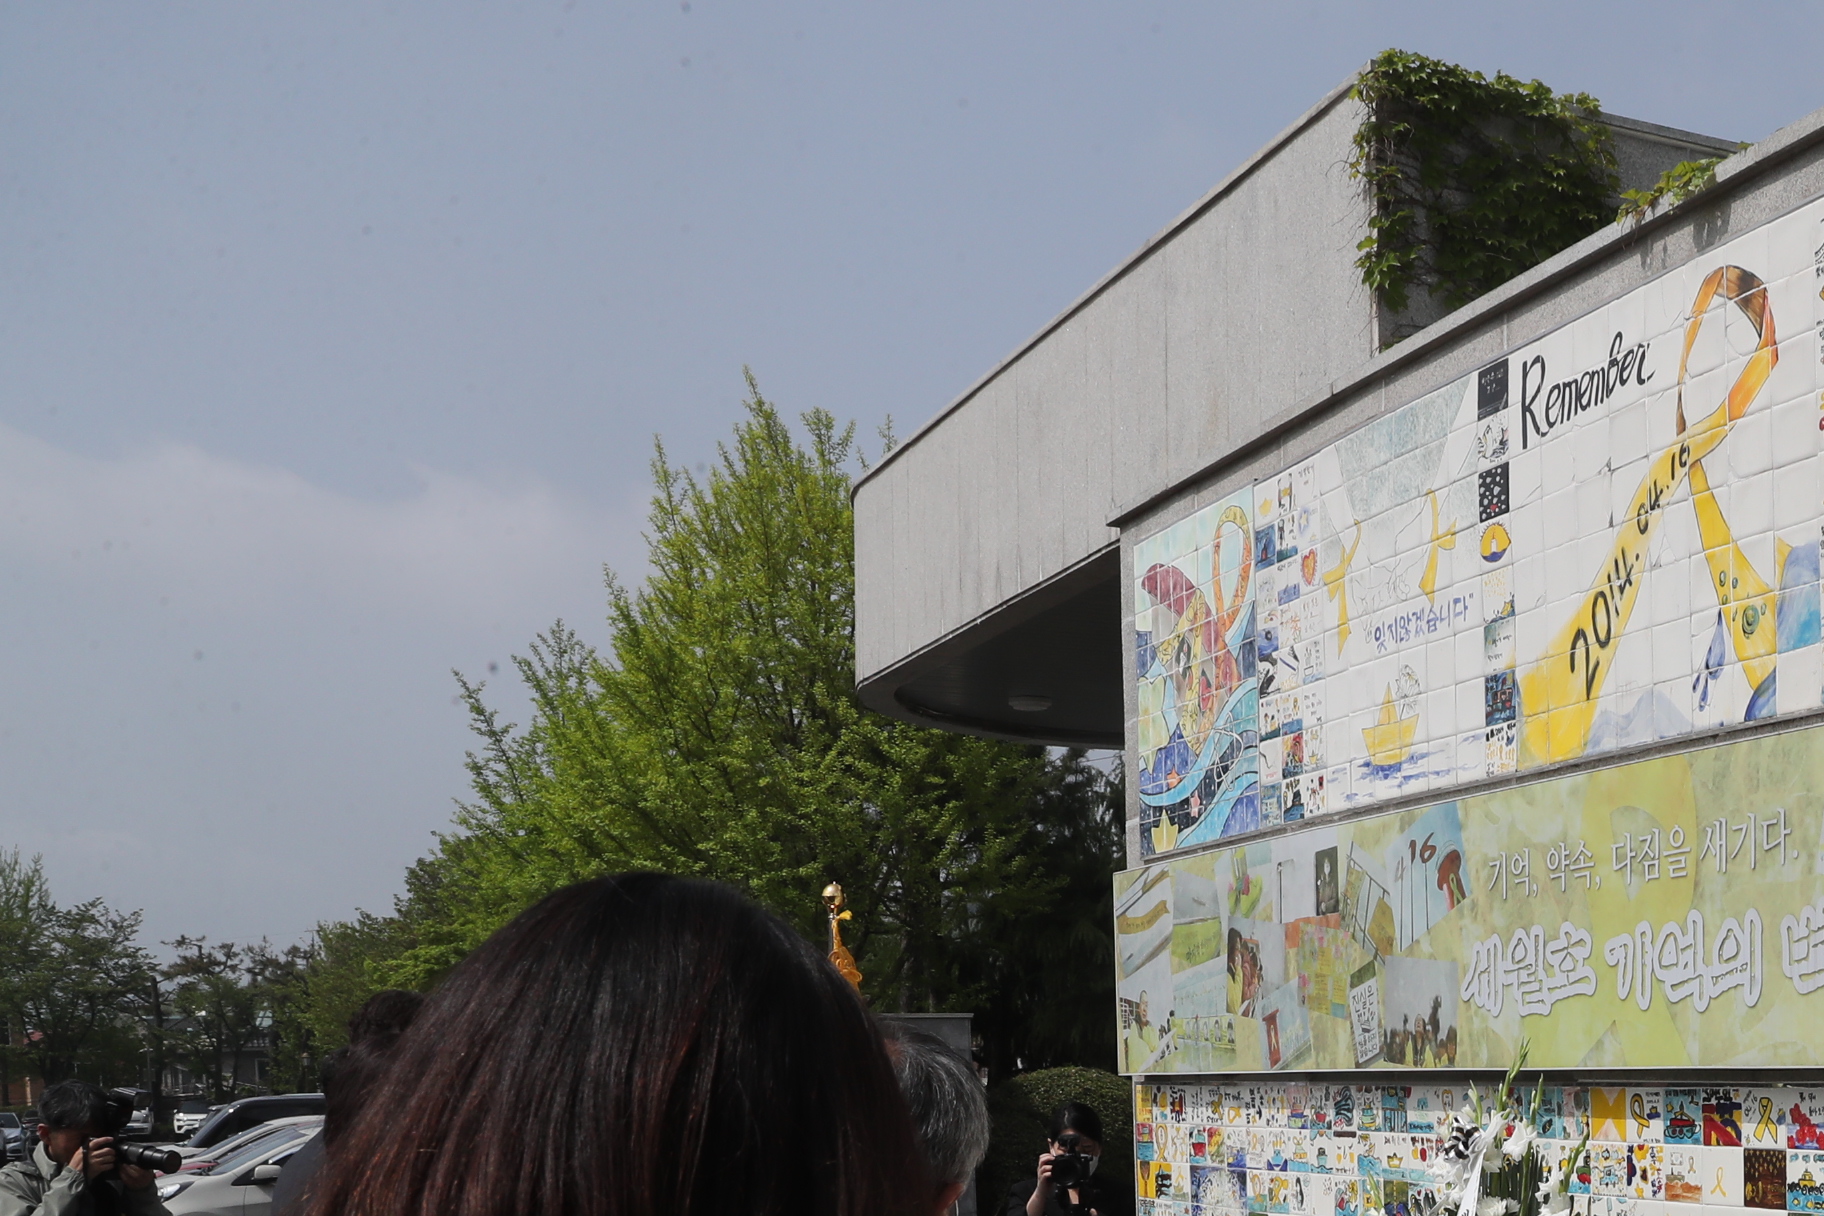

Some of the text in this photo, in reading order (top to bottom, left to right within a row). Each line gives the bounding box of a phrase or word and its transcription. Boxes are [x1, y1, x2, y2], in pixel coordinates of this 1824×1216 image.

[1489, 808, 1800, 900] 기억, 약속, 다짐을 새기다.
[1463, 919, 1598, 1017] 세월호
[1604, 907, 1764, 1013] 기억의
